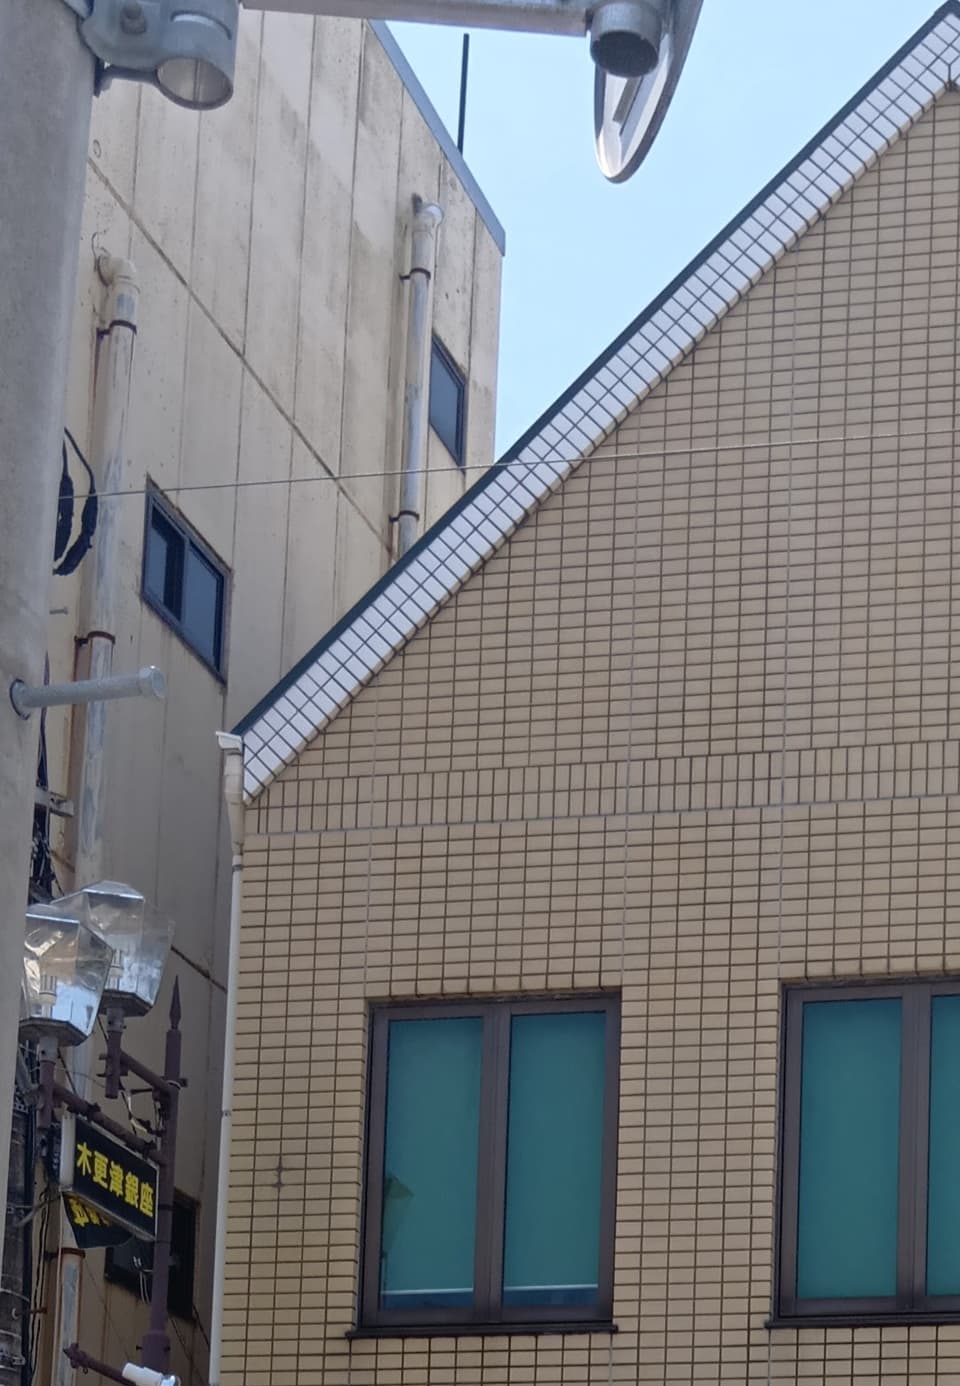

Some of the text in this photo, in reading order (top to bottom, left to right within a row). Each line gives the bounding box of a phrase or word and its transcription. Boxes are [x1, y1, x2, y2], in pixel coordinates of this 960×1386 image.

[77, 1142, 154, 1217] 木更津銀座
